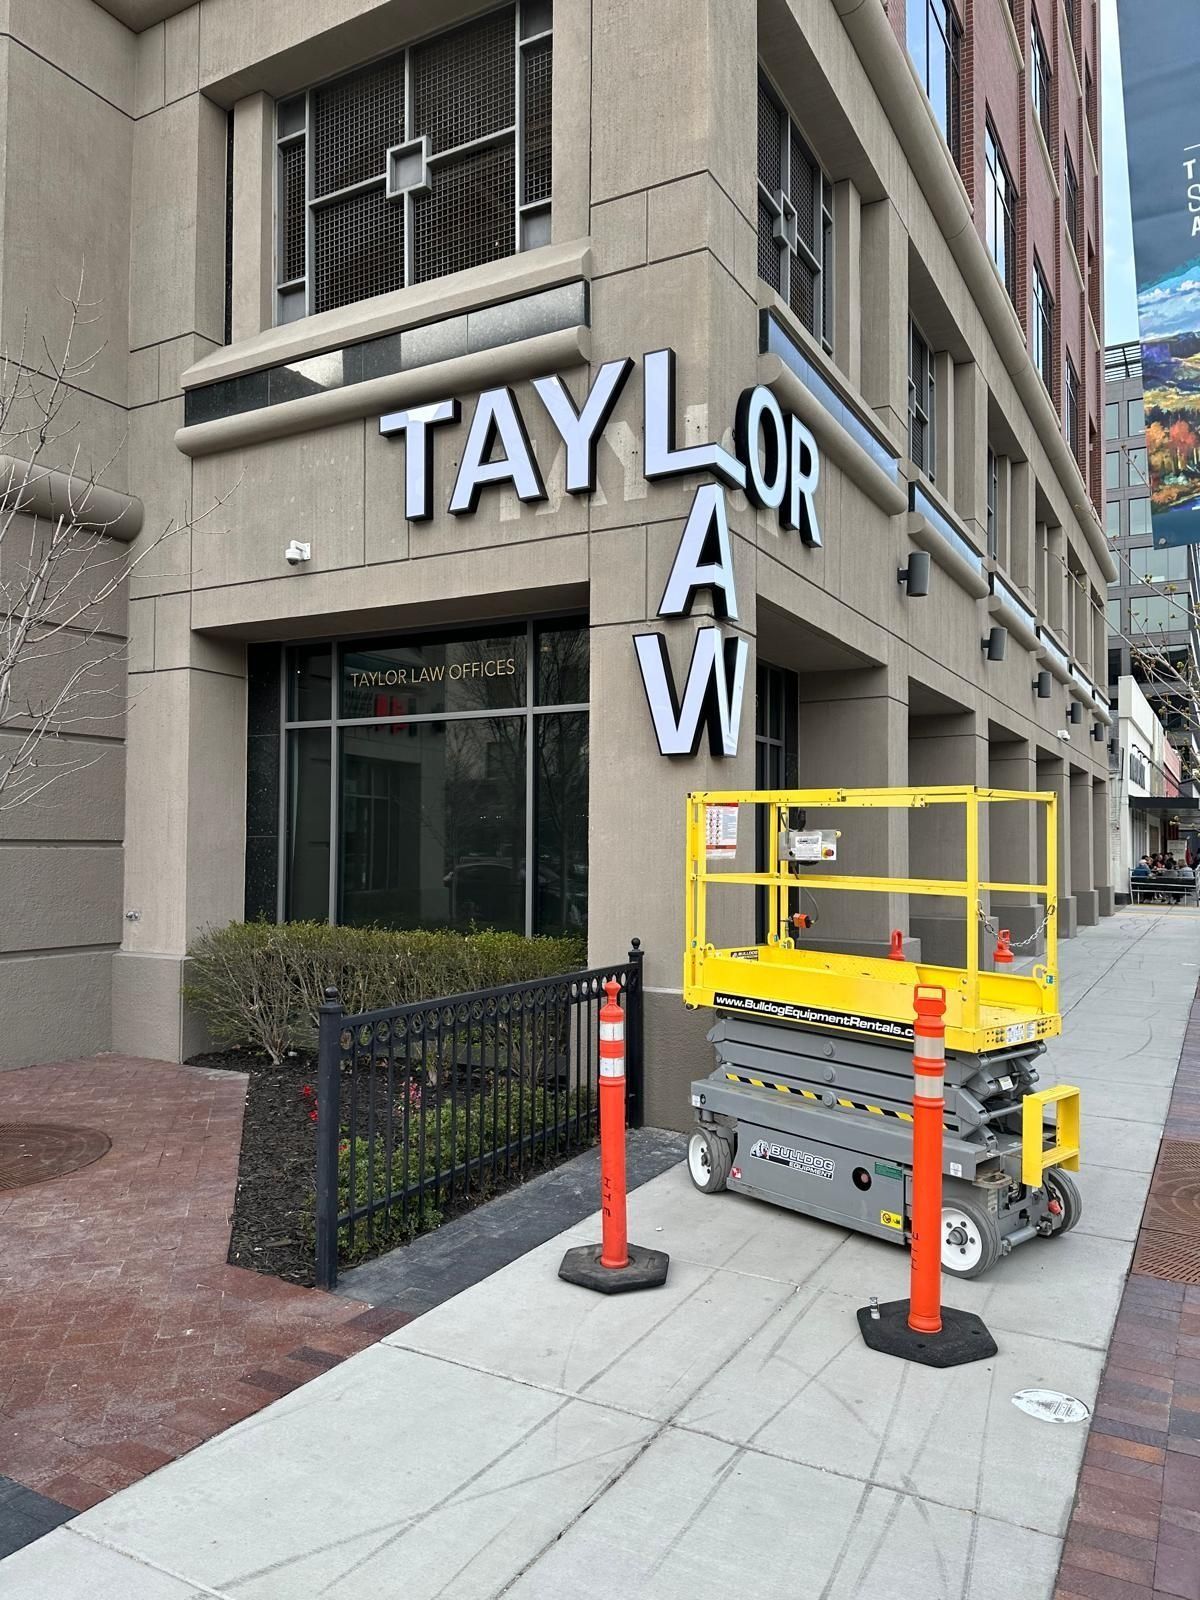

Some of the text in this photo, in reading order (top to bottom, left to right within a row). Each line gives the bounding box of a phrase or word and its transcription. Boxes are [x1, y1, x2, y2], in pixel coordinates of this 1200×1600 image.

[378, 347, 822, 548] TAYLOR
[351, 658, 516, 688] TAYLOR LAW OFFICES
[715, 995, 915, 1037] www.BulldogEquipmentRentals.c
[770, 1144, 835, 1172] BULLDOG
[788, 1160, 833, 1180] EQUIPMENT
